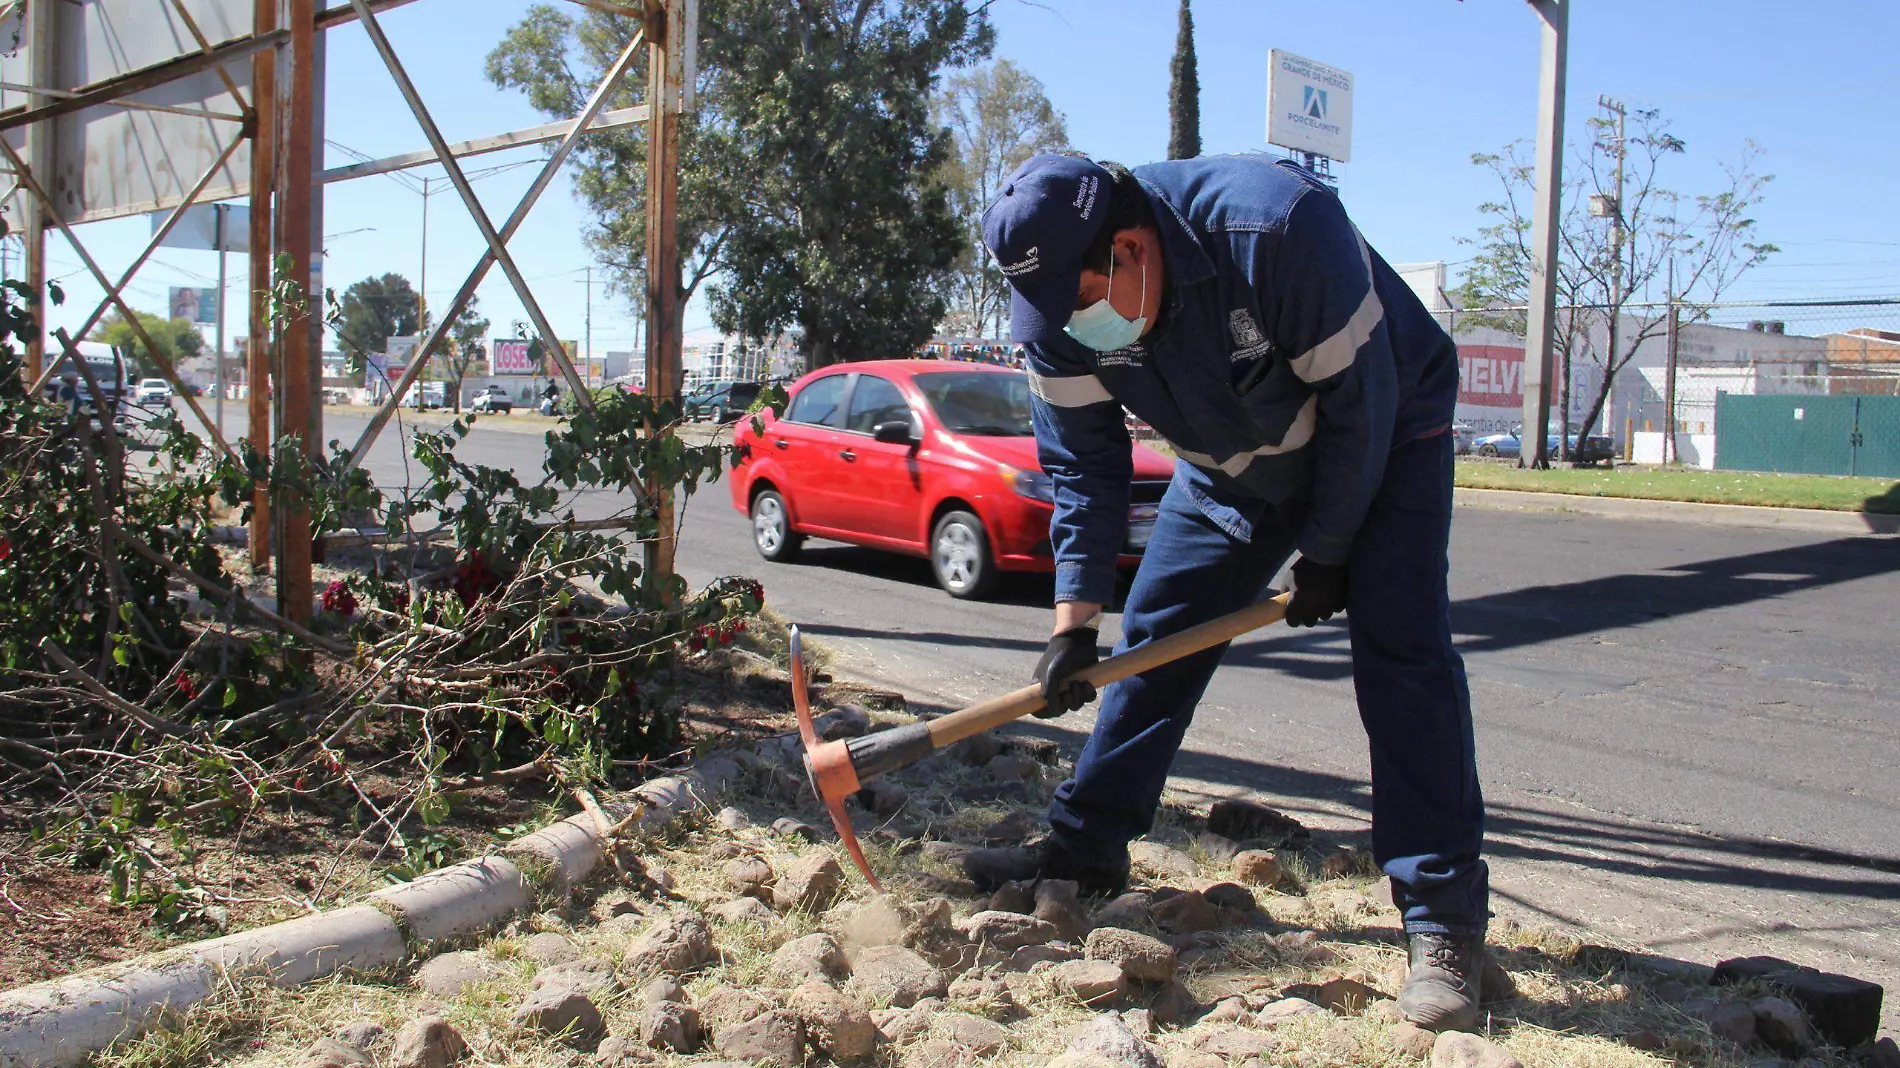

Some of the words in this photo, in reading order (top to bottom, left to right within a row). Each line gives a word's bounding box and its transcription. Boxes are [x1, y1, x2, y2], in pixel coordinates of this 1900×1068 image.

[1281, 61, 1311, 79] GRANDE
[1312, 71, 1321, 82] DE
[1288, 112, 1341, 135] PORCELANITE
[496, 343, 532, 368] LOSE
[1494, 415, 1508, 432] de
